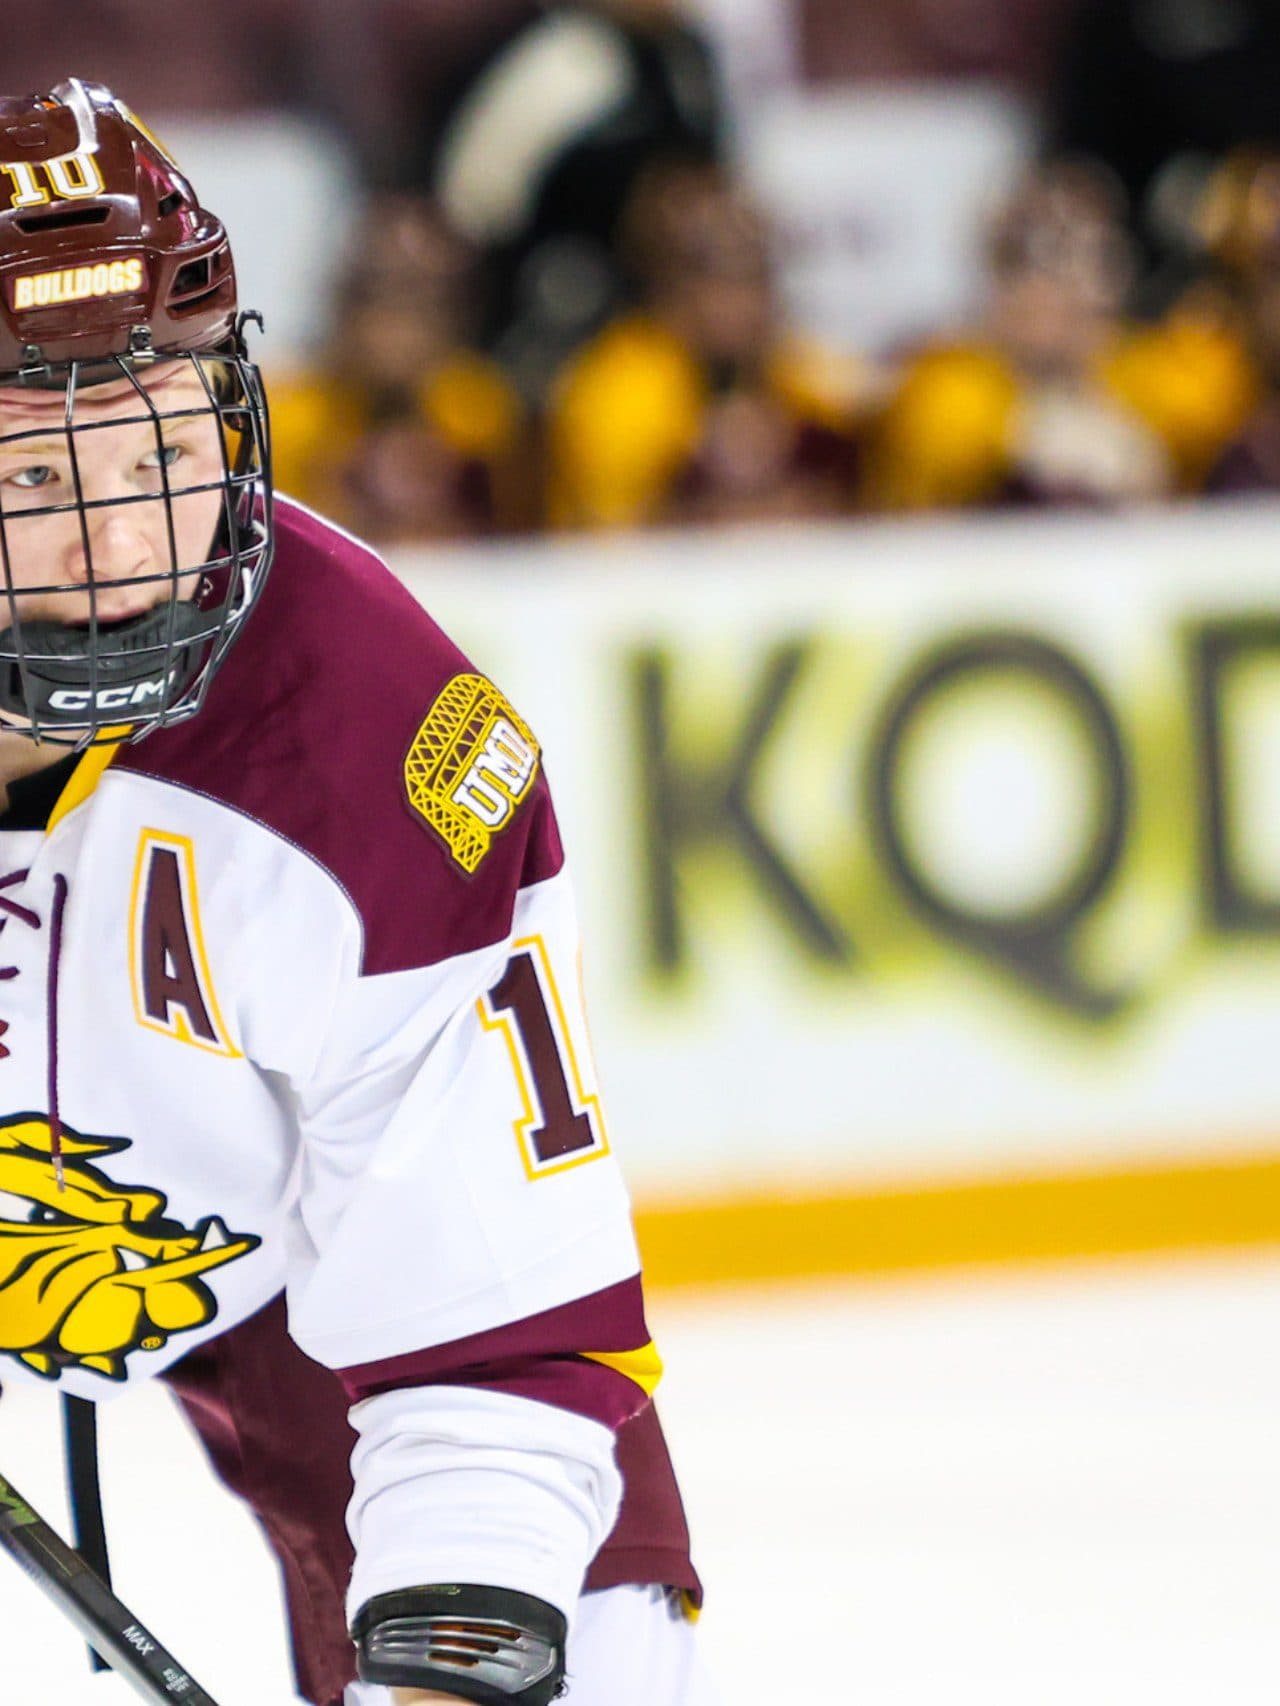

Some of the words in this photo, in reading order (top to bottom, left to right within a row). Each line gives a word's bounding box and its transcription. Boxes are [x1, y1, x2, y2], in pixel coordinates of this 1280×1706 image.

[0, 153, 106, 208] 10
[14, 258, 143, 310] BULLDOGS
[48, 671, 175, 710] CCM
[128, 827, 244, 1058] A
[475, 933, 610, 1182] 1
[122, 1625, 155, 1656] MAX
